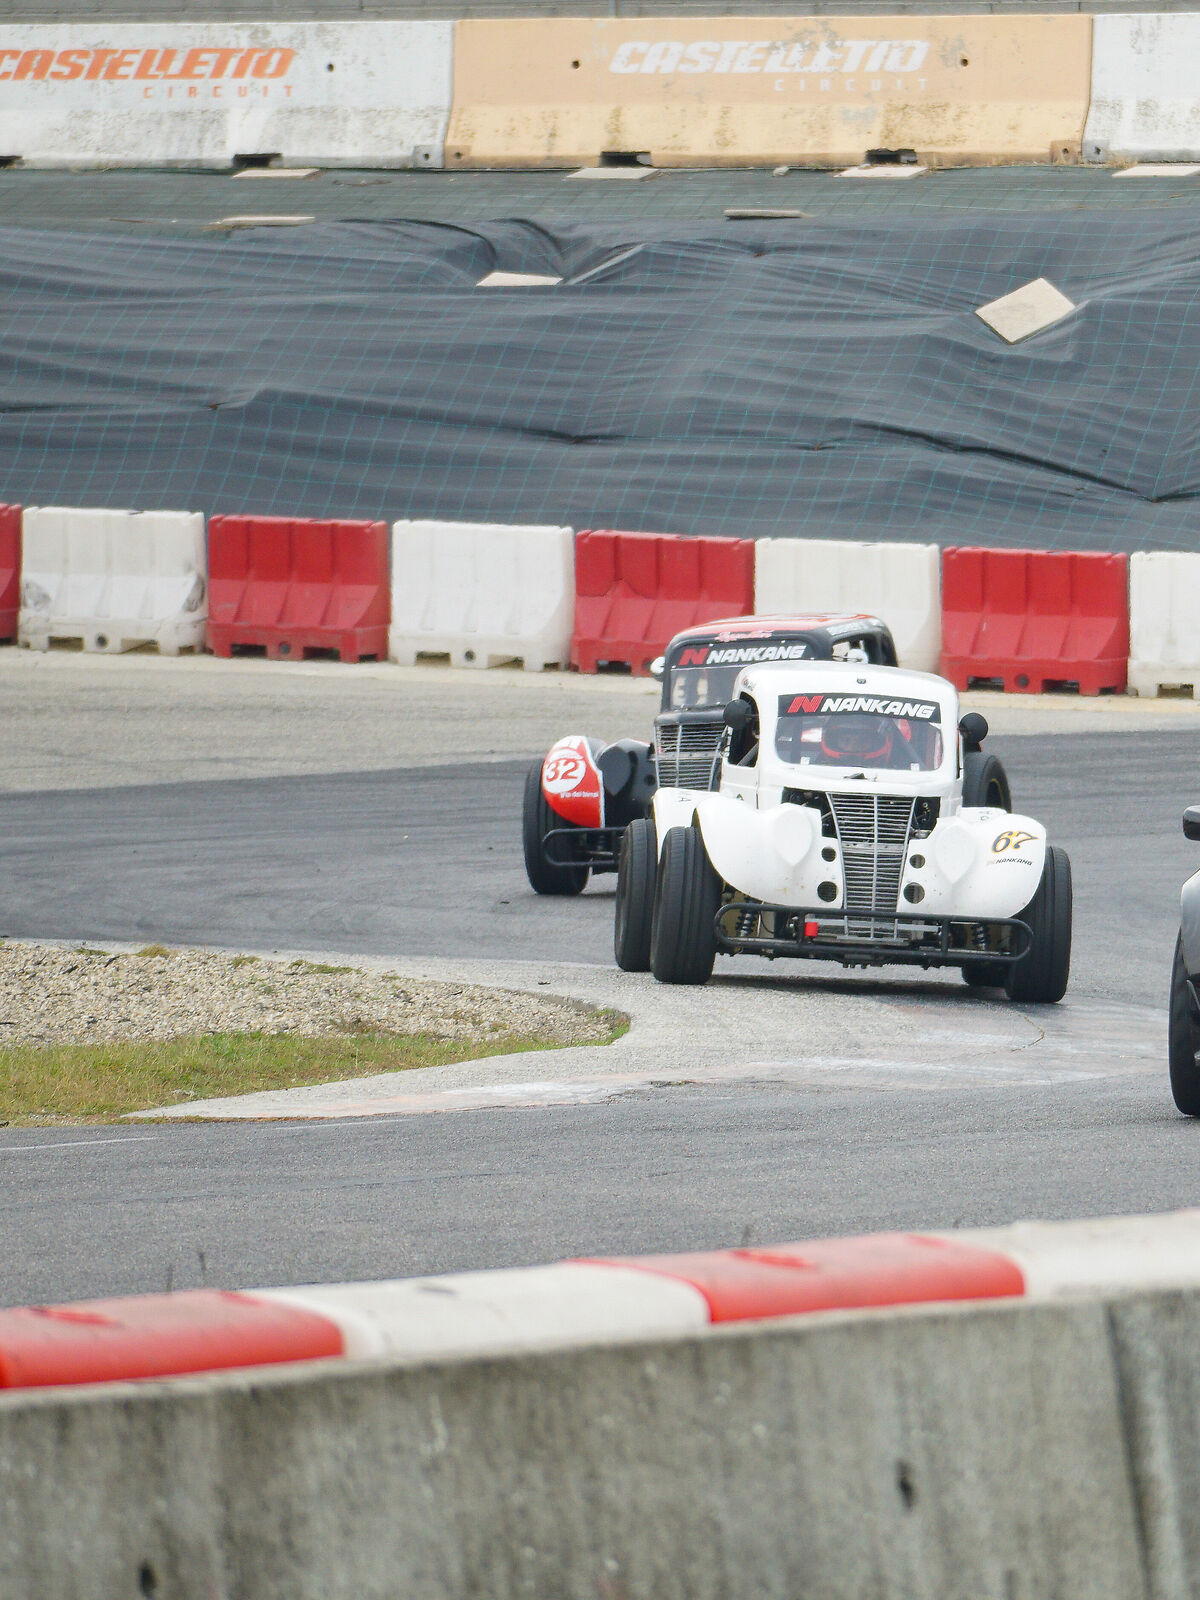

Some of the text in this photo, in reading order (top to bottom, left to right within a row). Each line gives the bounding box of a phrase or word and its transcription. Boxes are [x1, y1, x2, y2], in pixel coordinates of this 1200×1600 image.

[609, 40, 930, 74] CASTELLETTO
[143, 85, 294, 99] CIRCUIT
[774, 78, 928, 92] CIRCUIT
[706, 645, 807, 665] NANKANG
[820, 696, 936, 720] NANKANG
[546, 757, 579, 783] 32
[991, 830, 1039, 854] 67
